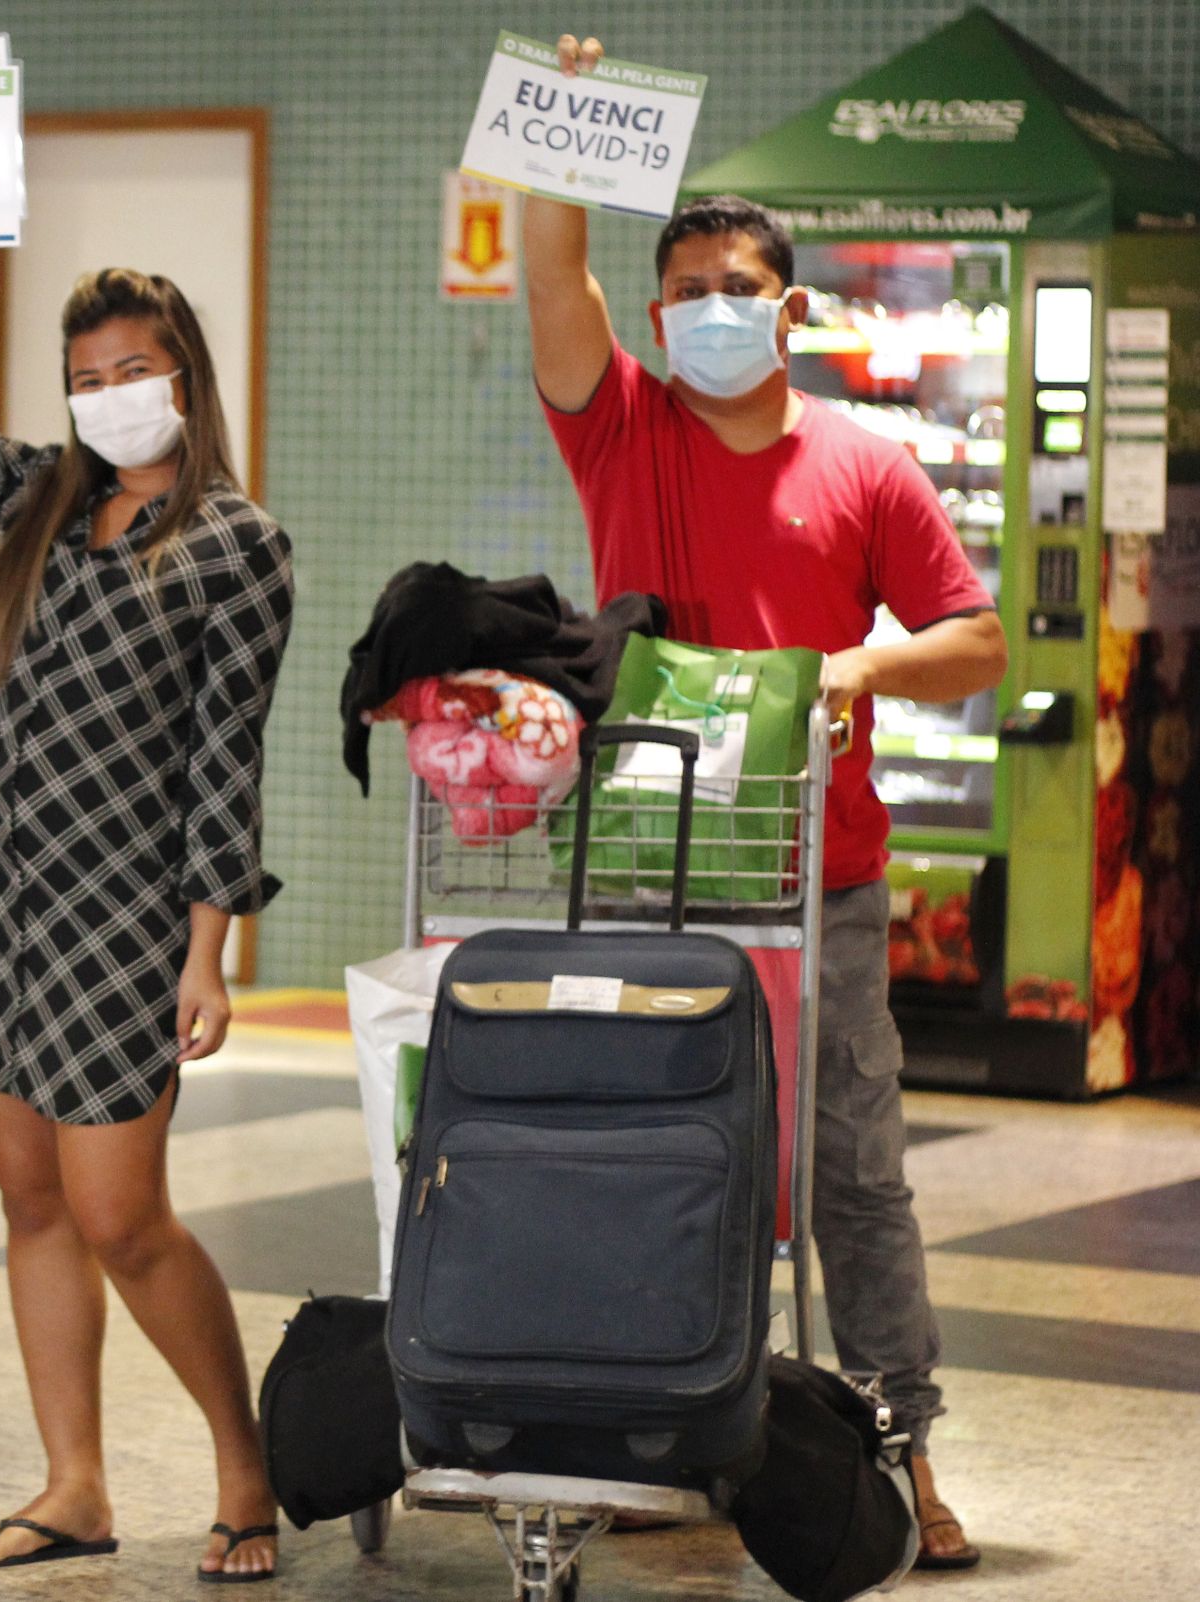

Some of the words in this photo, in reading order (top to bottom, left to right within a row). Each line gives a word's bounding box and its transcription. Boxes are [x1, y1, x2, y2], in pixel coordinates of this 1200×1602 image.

[503, 38, 516, 52] O
[518, 43, 560, 67] TRABA
[593, 64, 620, 80] ALA
[622, 68, 653, 87] PELA
[655, 75, 698, 95] GENTE
[515, 79, 557, 112] EU
[567, 93, 666, 135] VENCI
[488, 109, 510, 136] A
[522, 118, 671, 171] COVID-19
